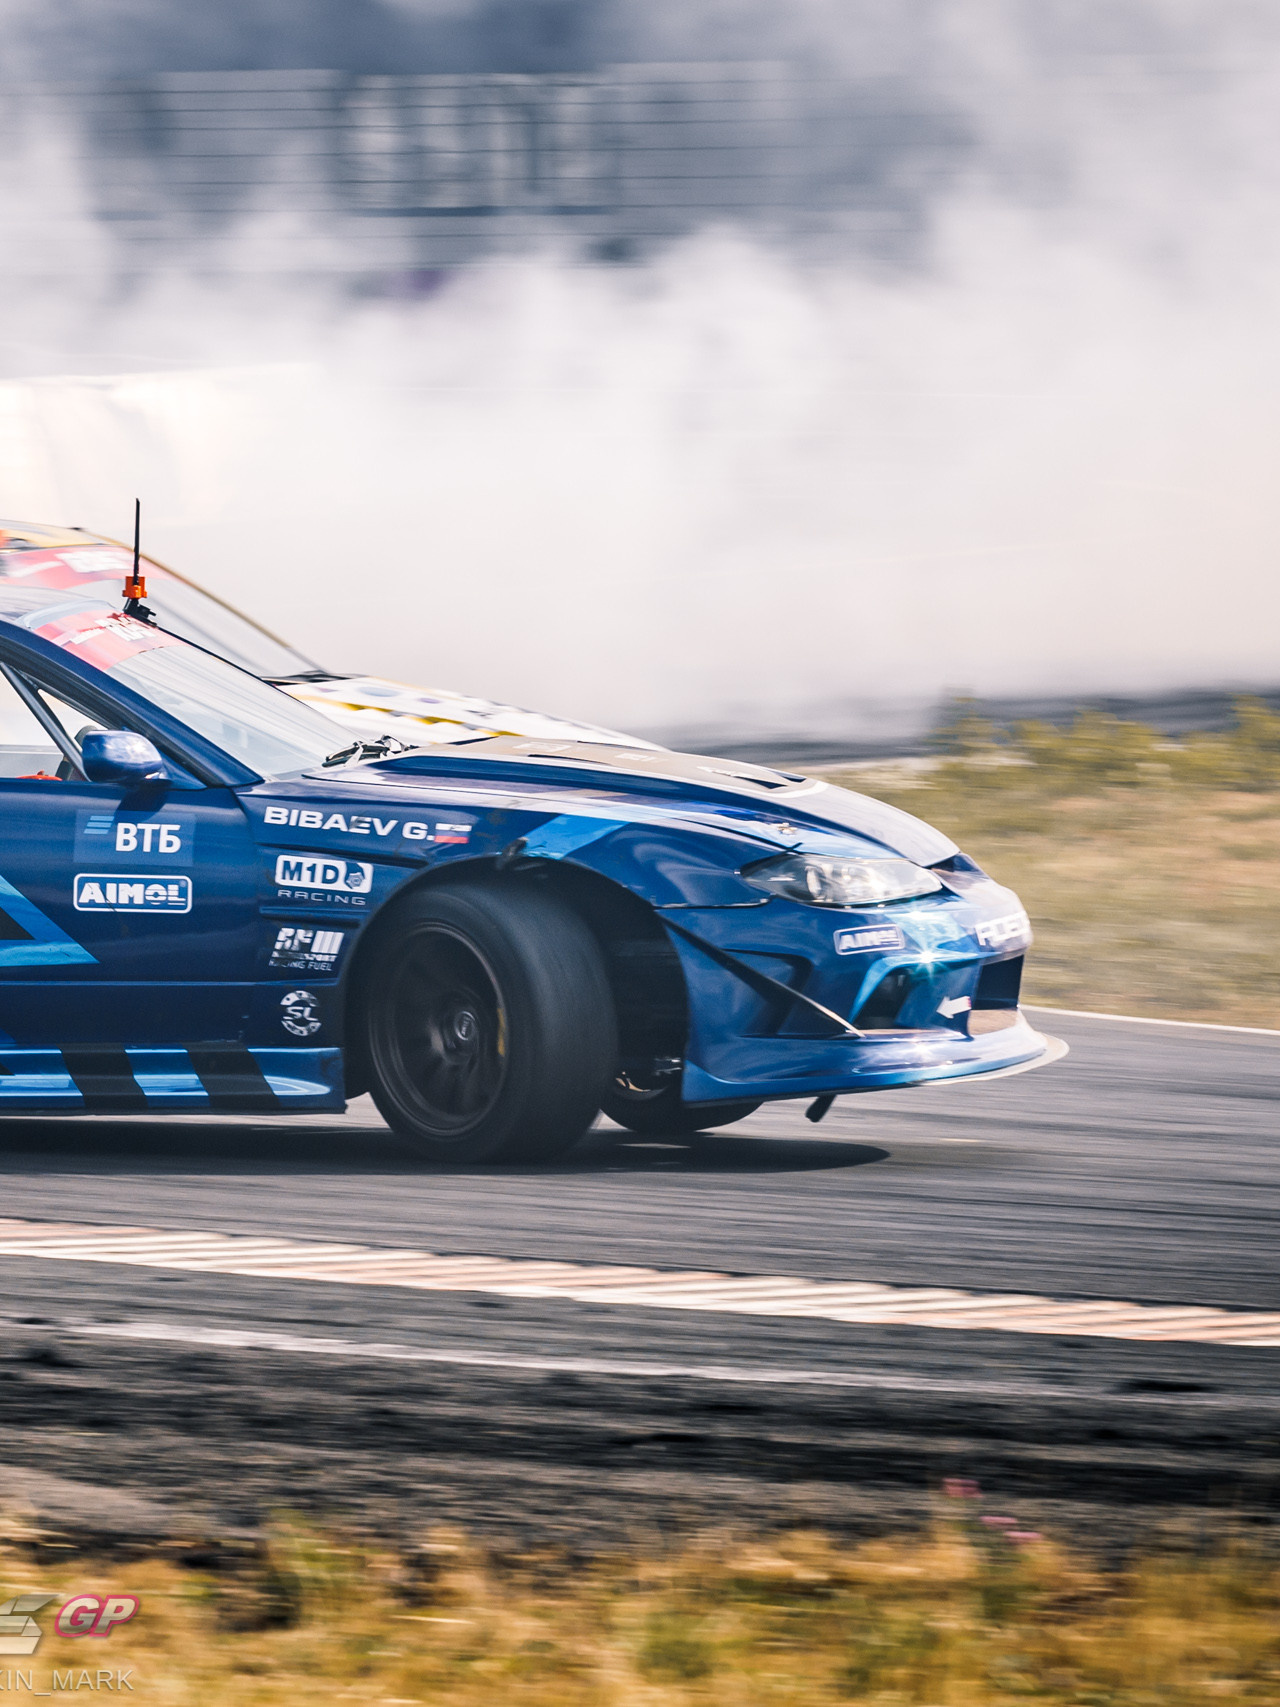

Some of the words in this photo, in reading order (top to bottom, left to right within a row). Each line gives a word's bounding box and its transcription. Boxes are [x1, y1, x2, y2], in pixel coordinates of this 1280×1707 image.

[263, 806, 398, 836] BIBAEV
[281, 860, 340, 885] M1D
[78, 882, 186, 906] AIMOL
[277, 889, 366, 906] RACING
[307, 961, 333, 971] FUEL
